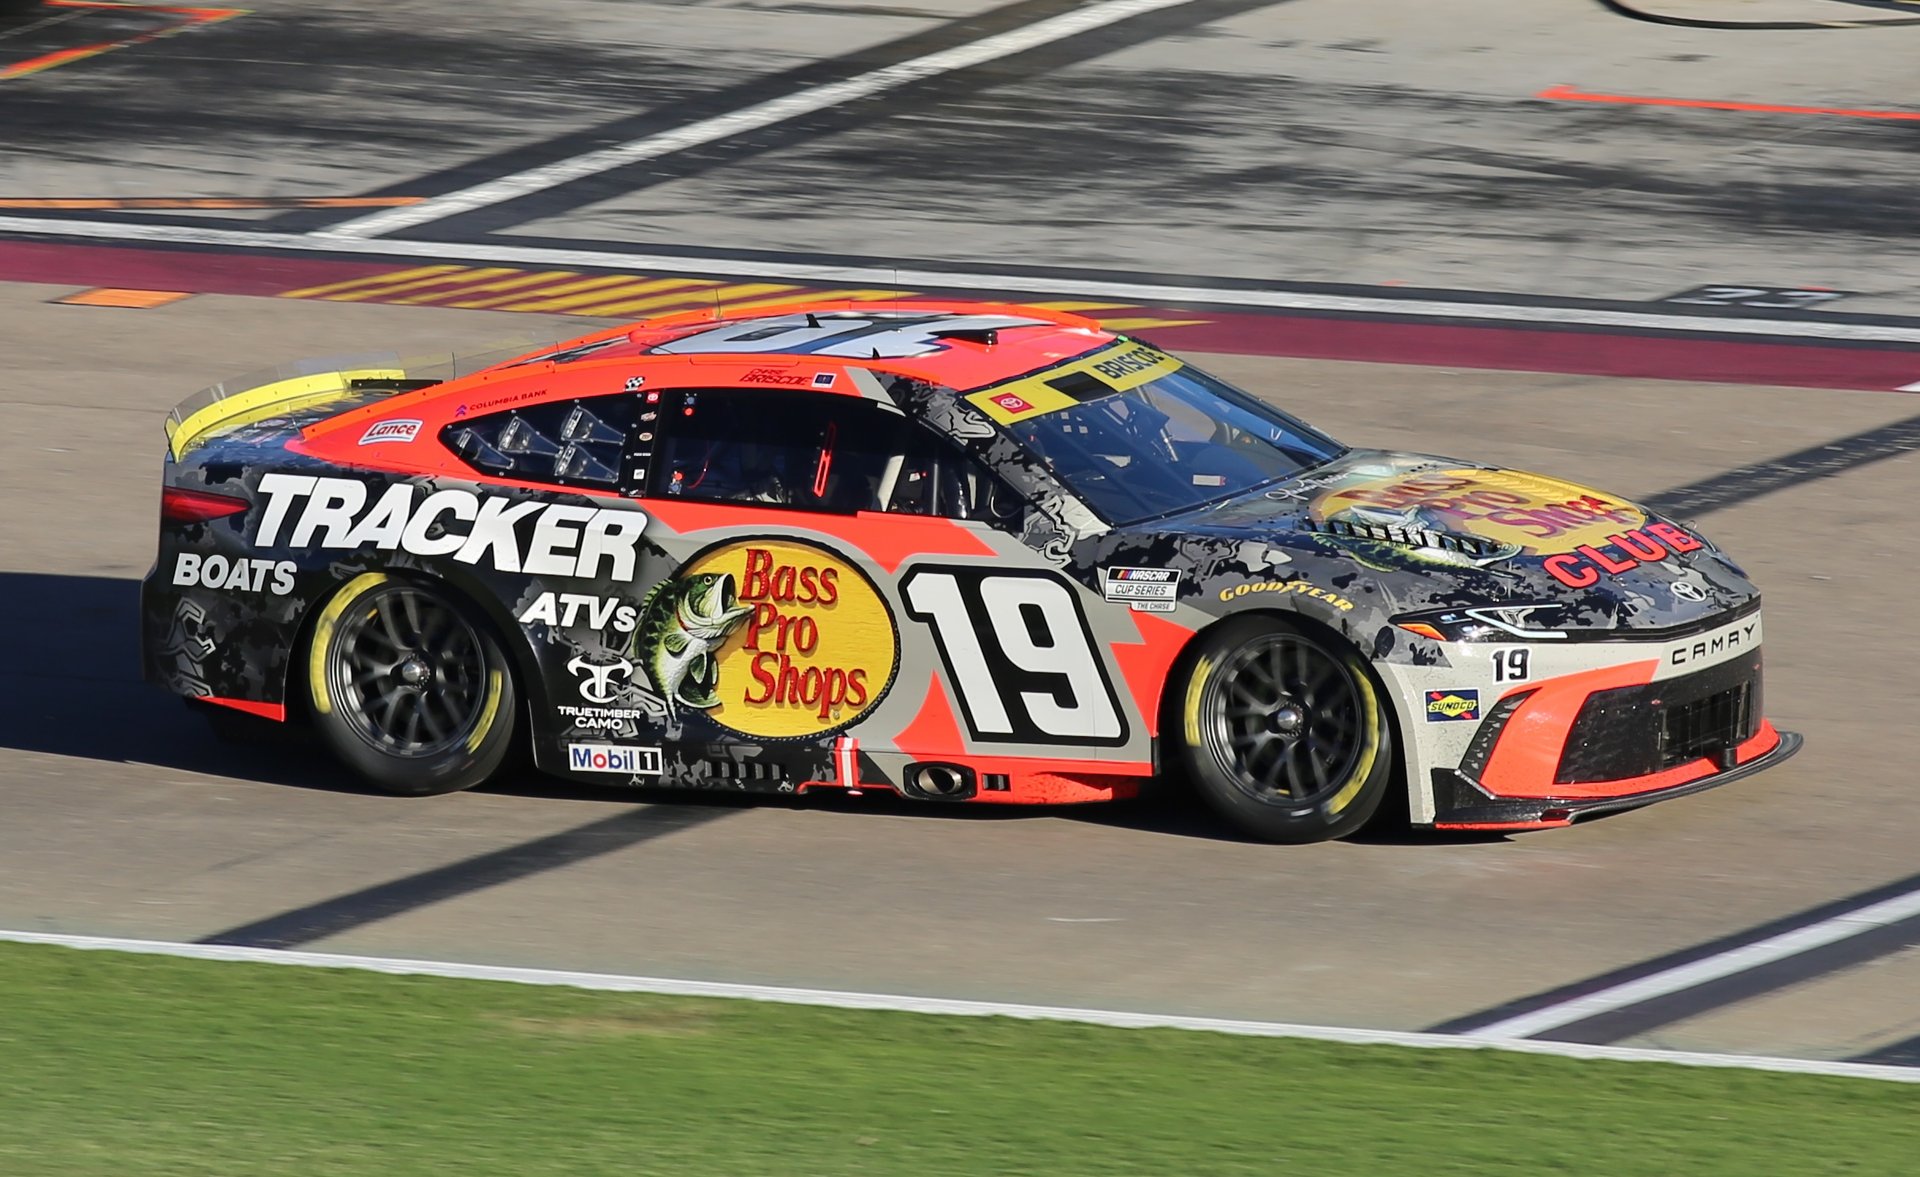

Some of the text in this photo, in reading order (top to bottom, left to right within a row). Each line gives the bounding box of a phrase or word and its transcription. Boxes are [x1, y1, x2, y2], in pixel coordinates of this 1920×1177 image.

[1092, 346, 1165, 379] BRISCOE
[739, 374, 813, 385] BRISCOE
[469, 389, 548, 411] COLUMBIA BANK
[368, 421, 417, 437] Lance
[254, 473, 649, 582] TRACKER
[1542, 521, 1703, 589] CLUB
[172, 552, 298, 596] BOATS
[738, 548, 839, 605] Bass
[1115, 584, 1167, 595] CUP SERIES
[1129, 570, 1170, 582] NASCAR
[519, 591, 637, 633] ATVs
[1219, 580, 1355, 612] GOODYEAR
[743, 602, 819, 652] Pro
[905, 572, 1123, 741] 19
[1672, 623, 1758, 666] CAMRY
[1492, 648, 1530, 682] 19
[744, 651, 867, 719] Shops
[557, 705, 641, 719] TRUETIMBER
[1430, 701, 1475, 711] SUNOCO
[574, 717, 623, 730] CAMO
[572, 747, 635, 770] Mobil
